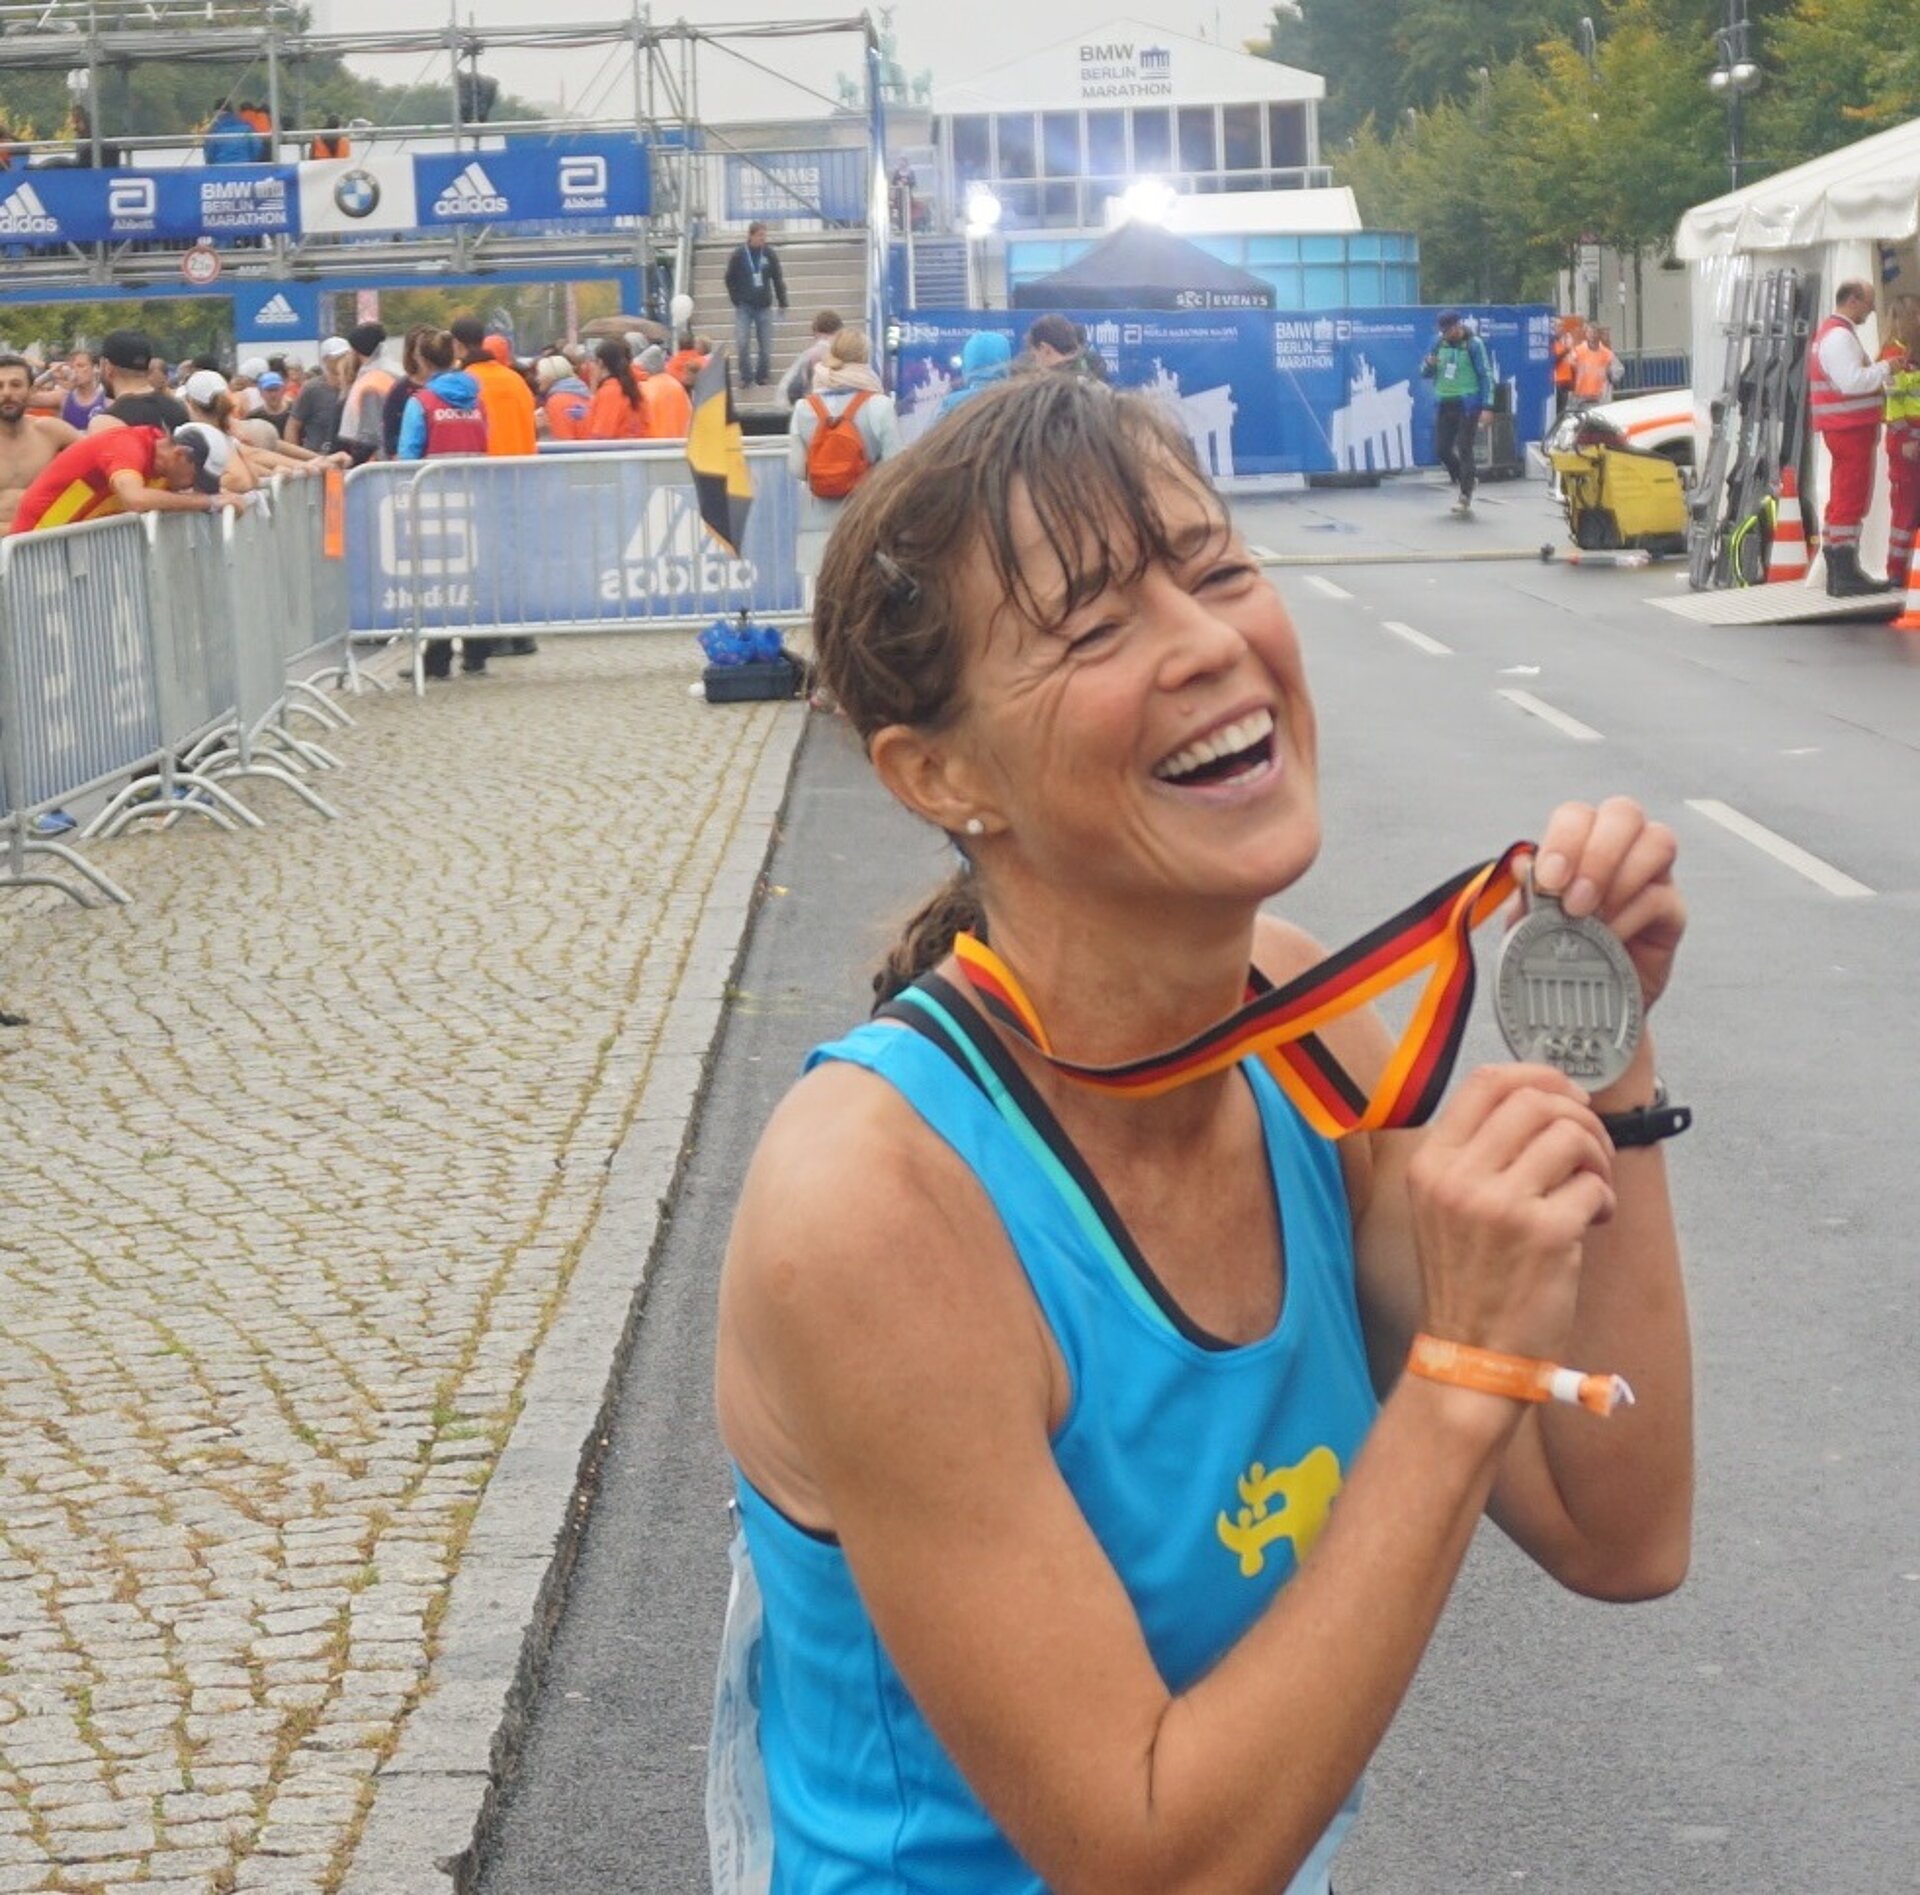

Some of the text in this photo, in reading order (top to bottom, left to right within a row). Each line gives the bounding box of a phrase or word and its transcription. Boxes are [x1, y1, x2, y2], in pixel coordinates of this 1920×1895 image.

[1080, 43, 1134, 61] BMW
[1080, 66, 1136, 81] BERLIN
[1081, 81, 1172, 98] MARATHON
[201, 181, 252, 200] BMW
[202, 199, 255, 214] BERLIN
[433, 197, 509, 216] adidas
[0, 213, 59, 232] didas
[202, 211, 287, 227] MARATHON
[1213, 294, 1269, 306] EVENTS
[1275, 321, 1313, 340] BMW
[1276, 341, 1313, 355] BERLIN
[1276, 355, 1334, 369] MARATHON
